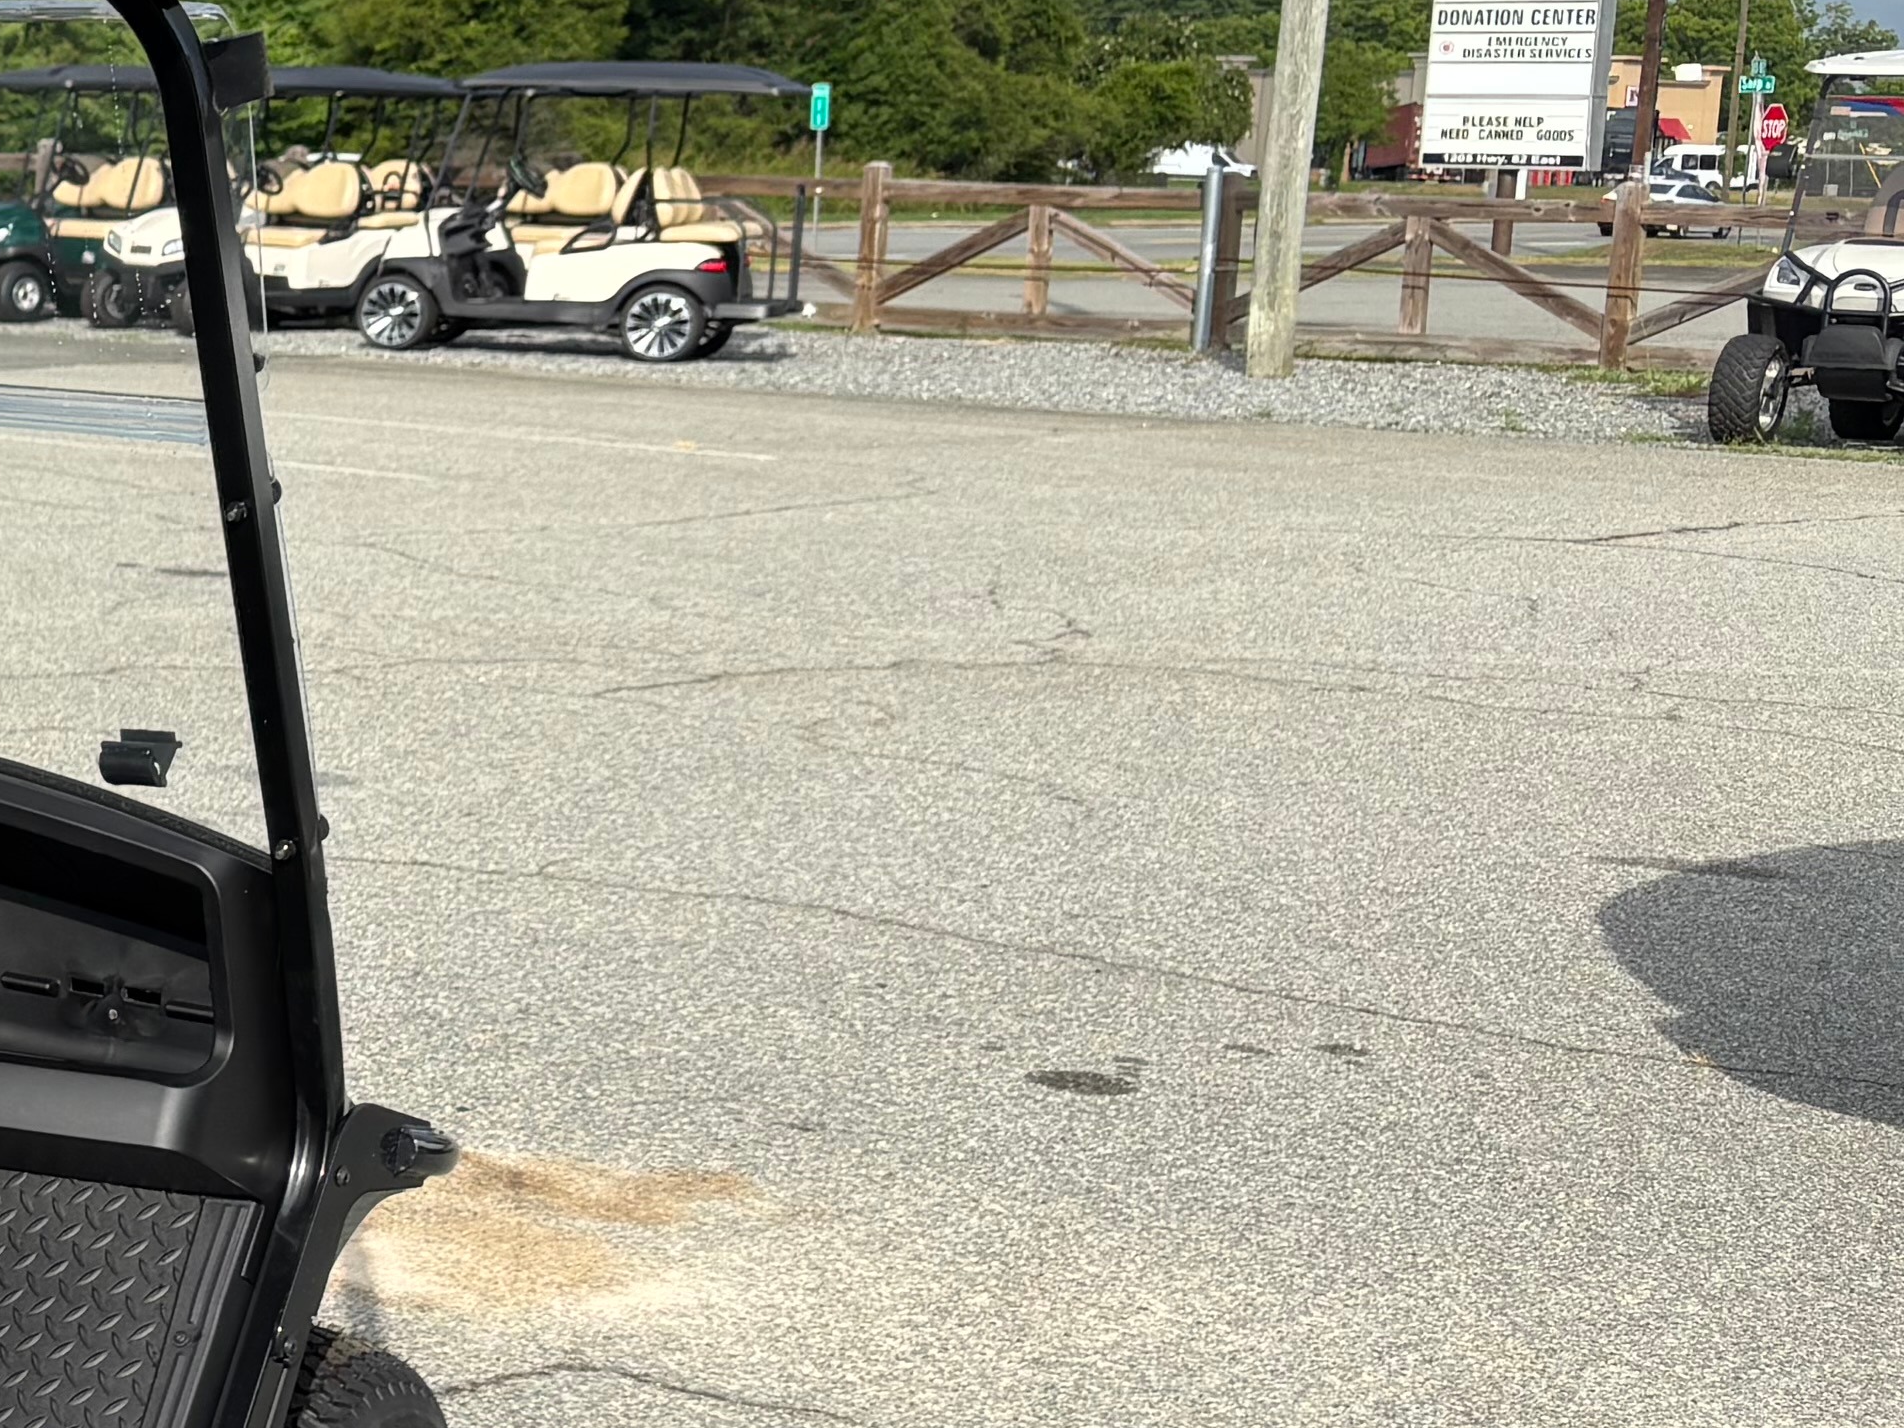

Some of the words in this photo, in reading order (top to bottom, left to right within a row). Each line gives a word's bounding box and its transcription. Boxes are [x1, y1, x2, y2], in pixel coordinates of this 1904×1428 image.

[1437, 9, 1524, 26] DONATION
[1531, 8, 1596, 25] CENTER
[1487, 36, 1568, 47] EMERGENCY
[1462, 48, 1526, 59] DISASTER
[1529, 47, 1592, 59] SERVICES
[1462, 115, 1509, 128] PLEASE
[1514, 115, 1545, 128] HELP
[1440, 128, 1470, 141] NEED
[1478, 128, 1524, 141] CANNED
[1536, 129, 1575, 142] GOODS
[1762, 119, 1786, 139] STOP
